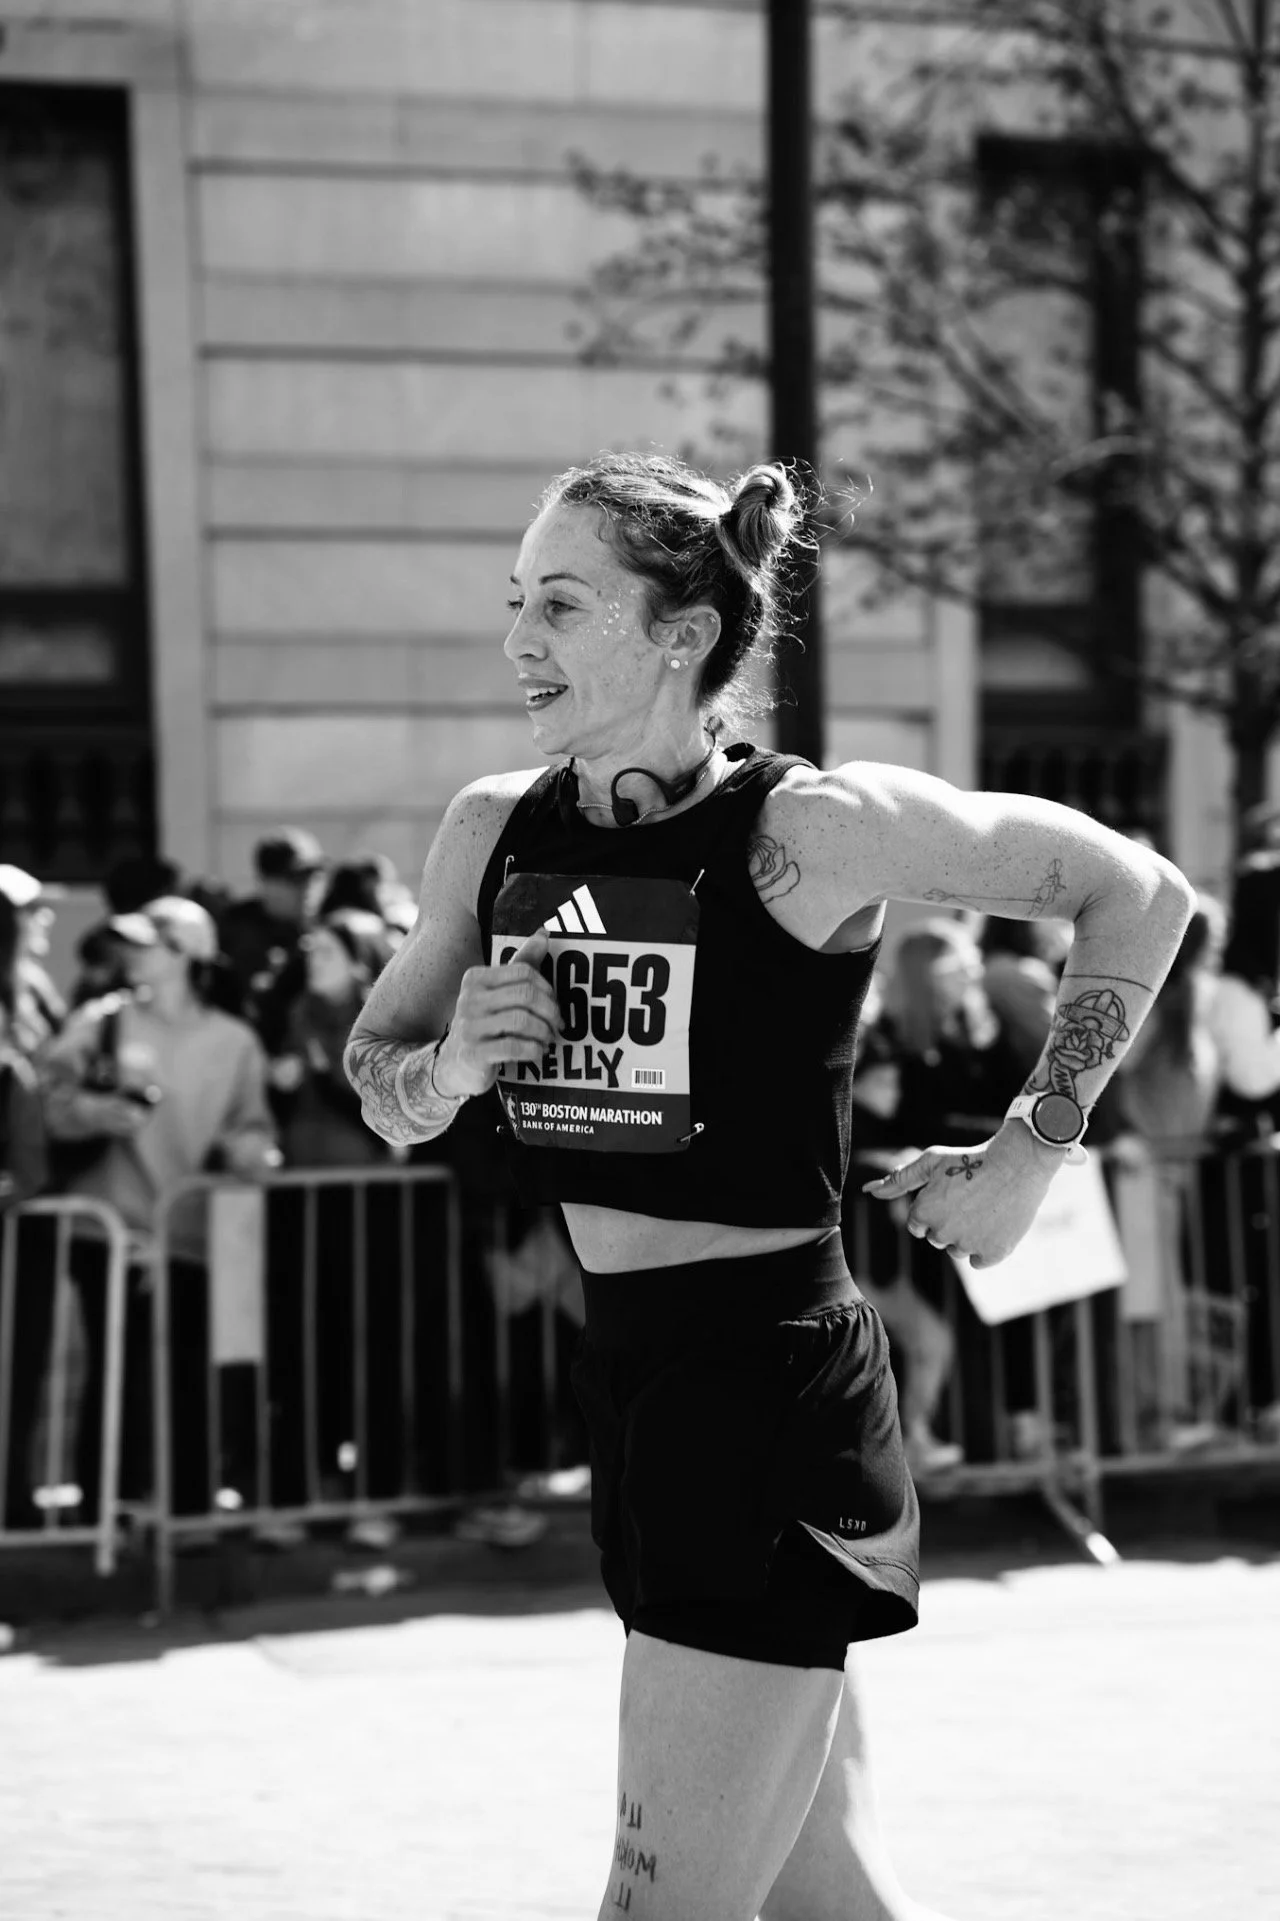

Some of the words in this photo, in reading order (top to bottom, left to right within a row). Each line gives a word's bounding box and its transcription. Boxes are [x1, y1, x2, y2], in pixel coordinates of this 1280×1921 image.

[500, 947, 671, 1046] 653
[542, 1104, 588, 1120] BOSTON
[589, 1107, 663, 1125] MARATHON
[522, 1120, 543, 1130] BANK
[543, 1122, 555, 1131] OF
[556, 1123, 595, 1134] AMERICA
